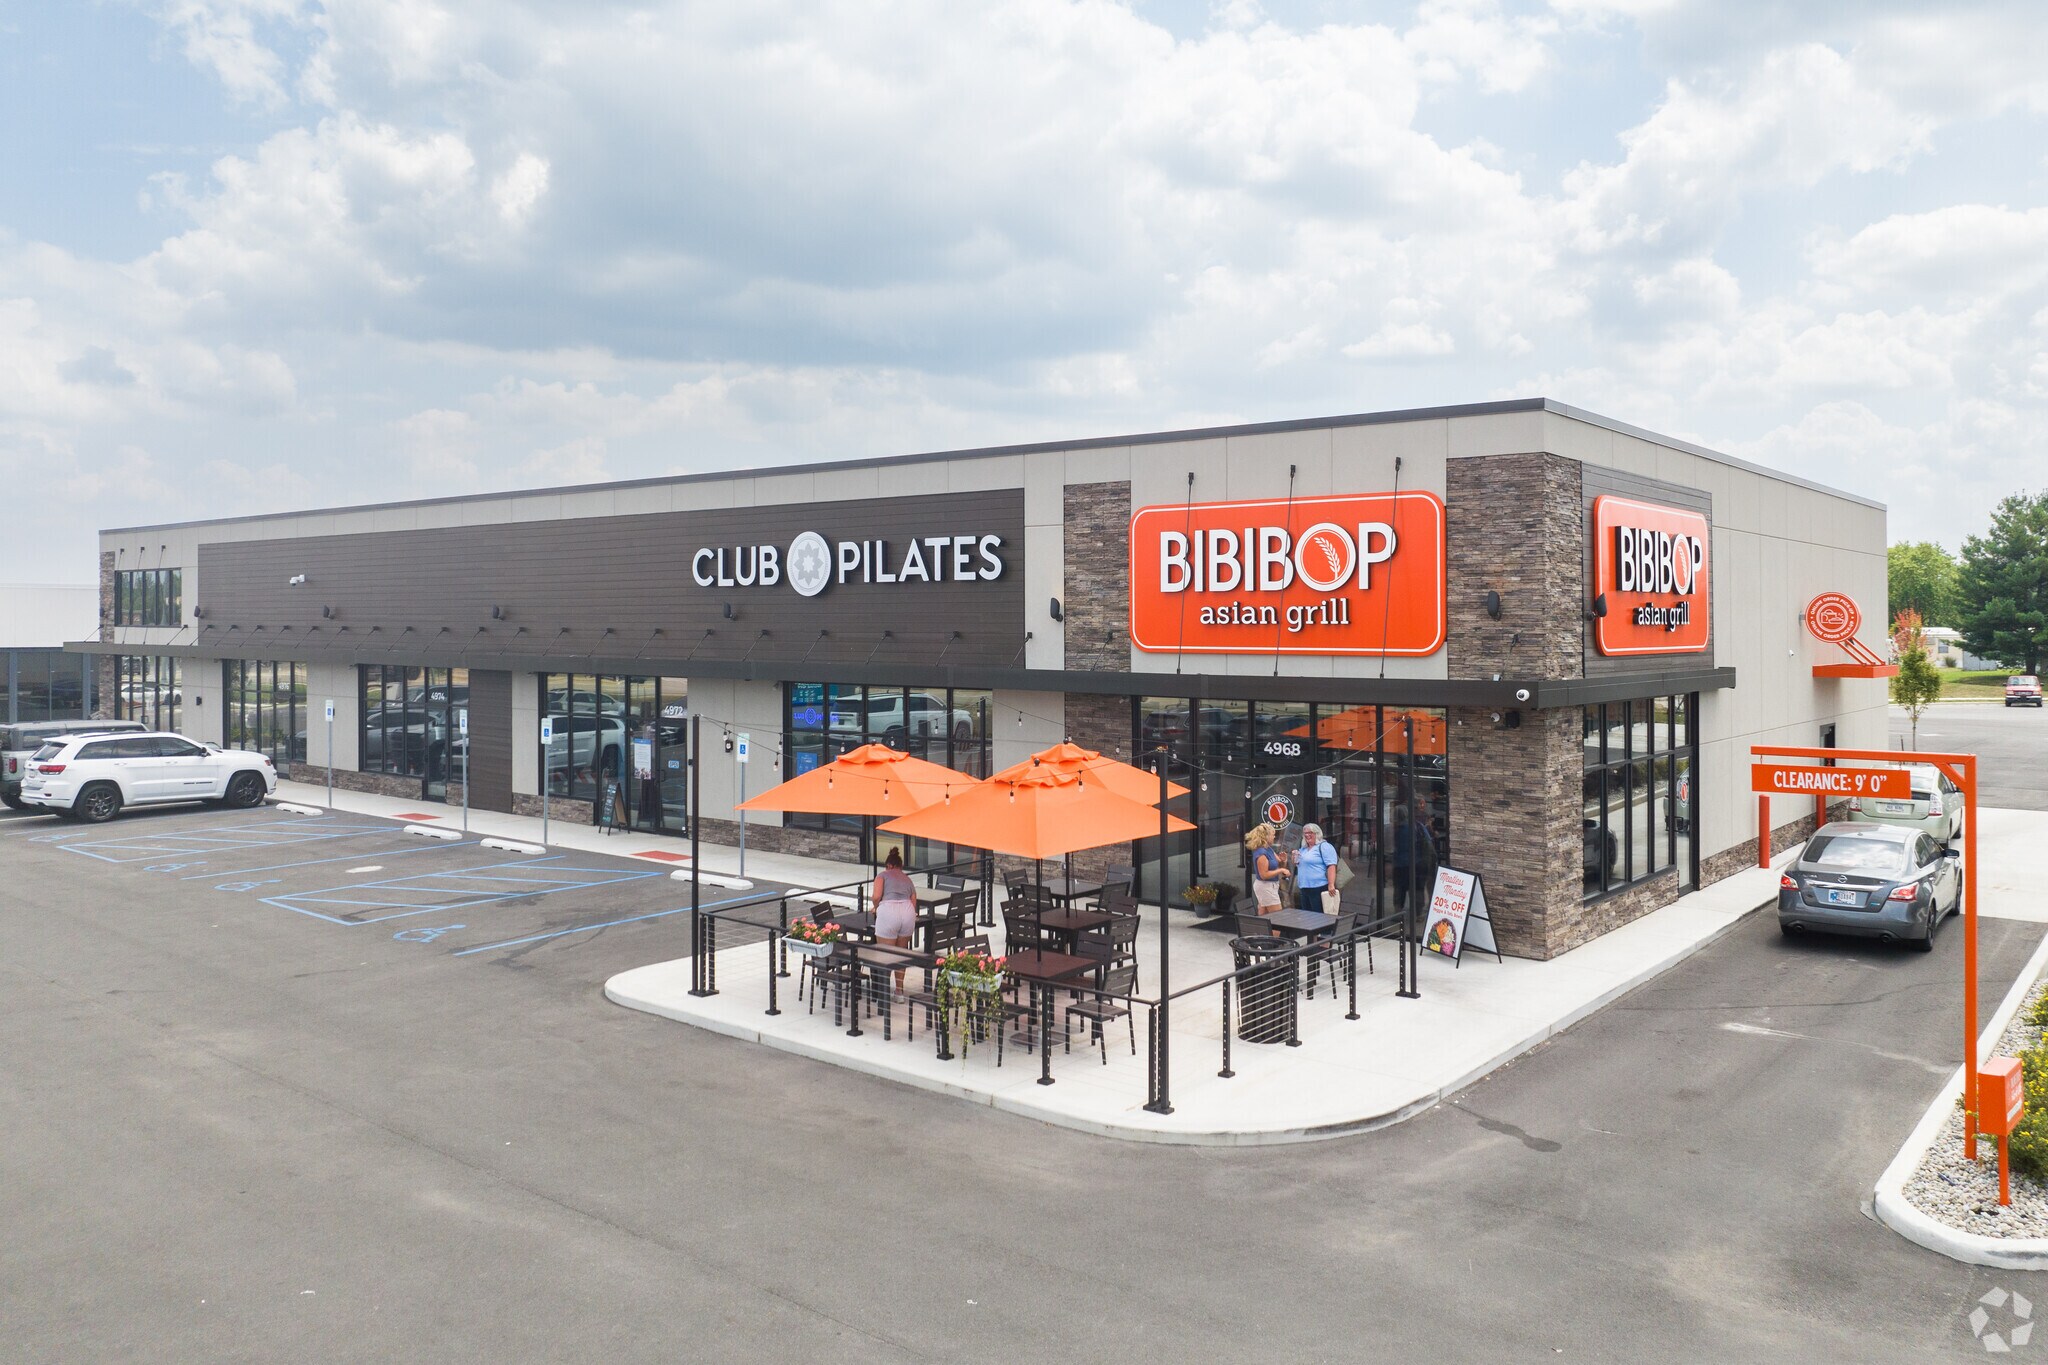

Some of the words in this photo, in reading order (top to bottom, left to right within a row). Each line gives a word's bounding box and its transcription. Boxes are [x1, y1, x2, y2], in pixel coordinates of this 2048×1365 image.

[692, 544, 780, 587] CLUB
[838, 534, 1002, 584] PILATES
[1160, 522, 1397, 593] BIBIBOP
[1620, 525, 1703, 596] BIBIBOP
[1200, 601, 1278, 625] asian
[1286, 598, 1350, 633] grill
[1638, 602, 1668, 625] asian
[1669, 601, 1690, 632] grill
[430, 691, 446, 701] 4974
[664, 705, 683, 715] 4972
[1263, 741, 1301, 756] 4968
[1773, 771, 1852, 791] CLEARANCE:
[1855, 774, 1867, 792] 9'
[1267, 796, 1289, 806] BIBIBOP
[1440, 872, 1464, 886] Meatless
[1443, 884, 1467, 901] Monday
[1434, 896, 1449, 909] 20%
[1451, 901, 1465, 913] OFF
